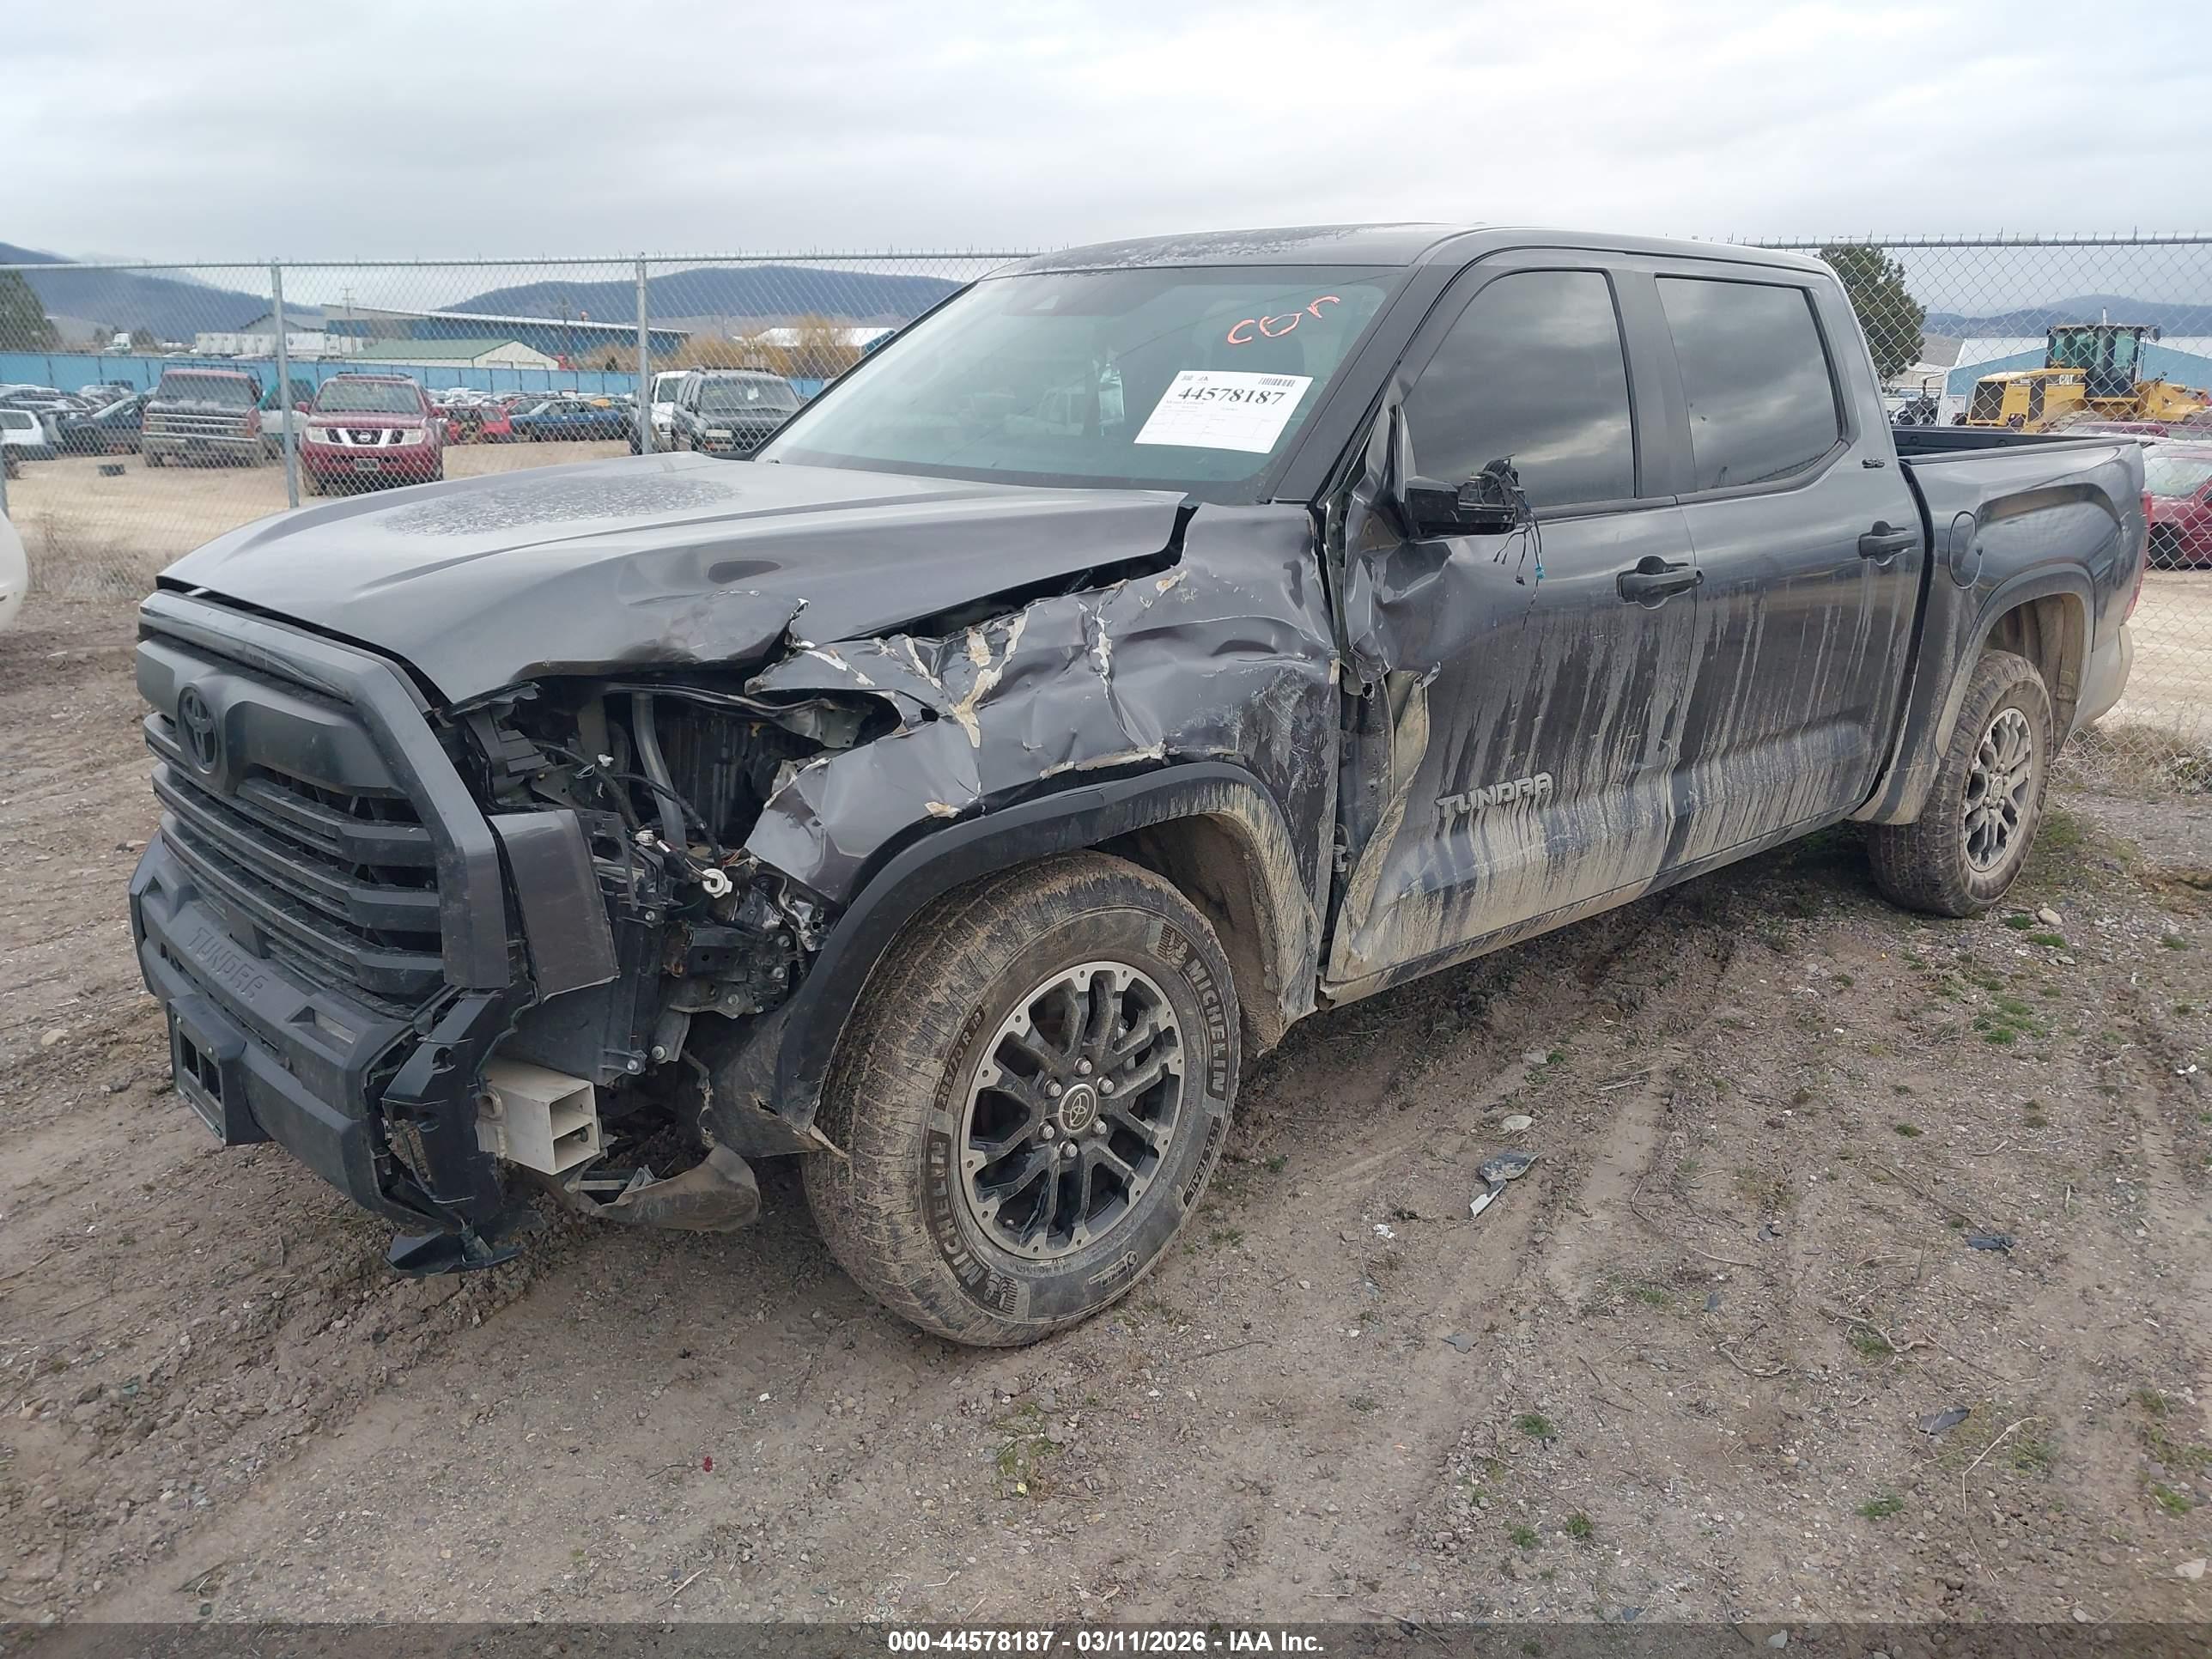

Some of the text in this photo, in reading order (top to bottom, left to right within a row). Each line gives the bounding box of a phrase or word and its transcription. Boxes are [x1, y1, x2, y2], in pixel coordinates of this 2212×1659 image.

[1178, 386, 1287, 405] 44578187
[2058, 374, 2075, 386] CAT
[1435, 771, 1554, 818] TUNDRA
[186, 927, 269, 1002] TUNDRA
[1185, 957, 1227, 1092] MICHELIN
[1187, 1158, 1209, 1194] TRAIL
[930, 1141, 986, 1286] MICHELIN
